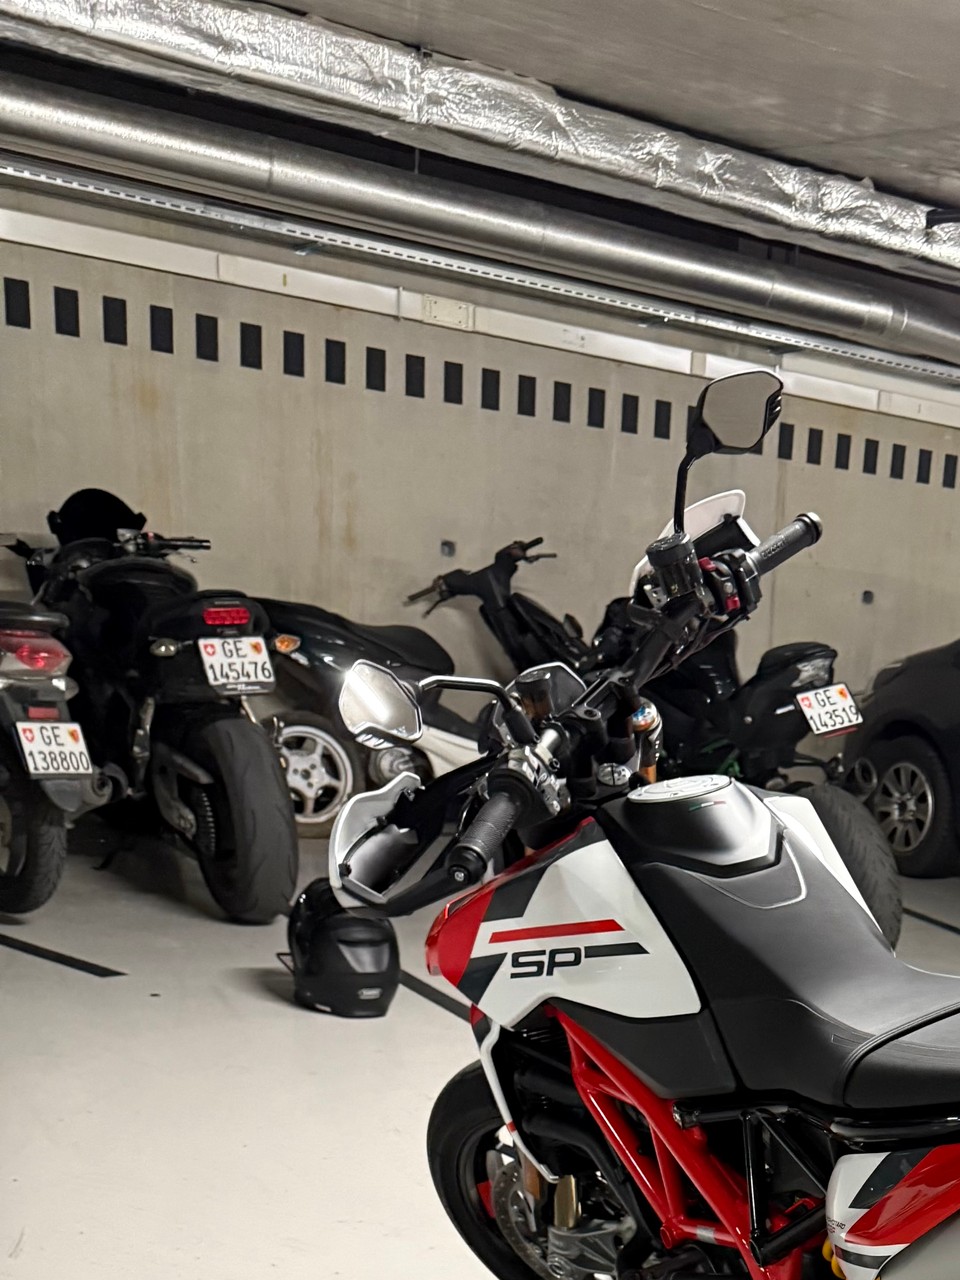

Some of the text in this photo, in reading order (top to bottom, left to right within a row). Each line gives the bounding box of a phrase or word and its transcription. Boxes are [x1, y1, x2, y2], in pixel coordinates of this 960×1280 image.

[221, 640, 247, 658] GE
[208, 661, 272, 682] 145476
[814, 689, 837, 708] GE
[809, 705, 860, 731] 143519
[39, 726, 65, 746] GE
[28, 750, 90, 771] 138800
[510, 947, 582, 979] SP
